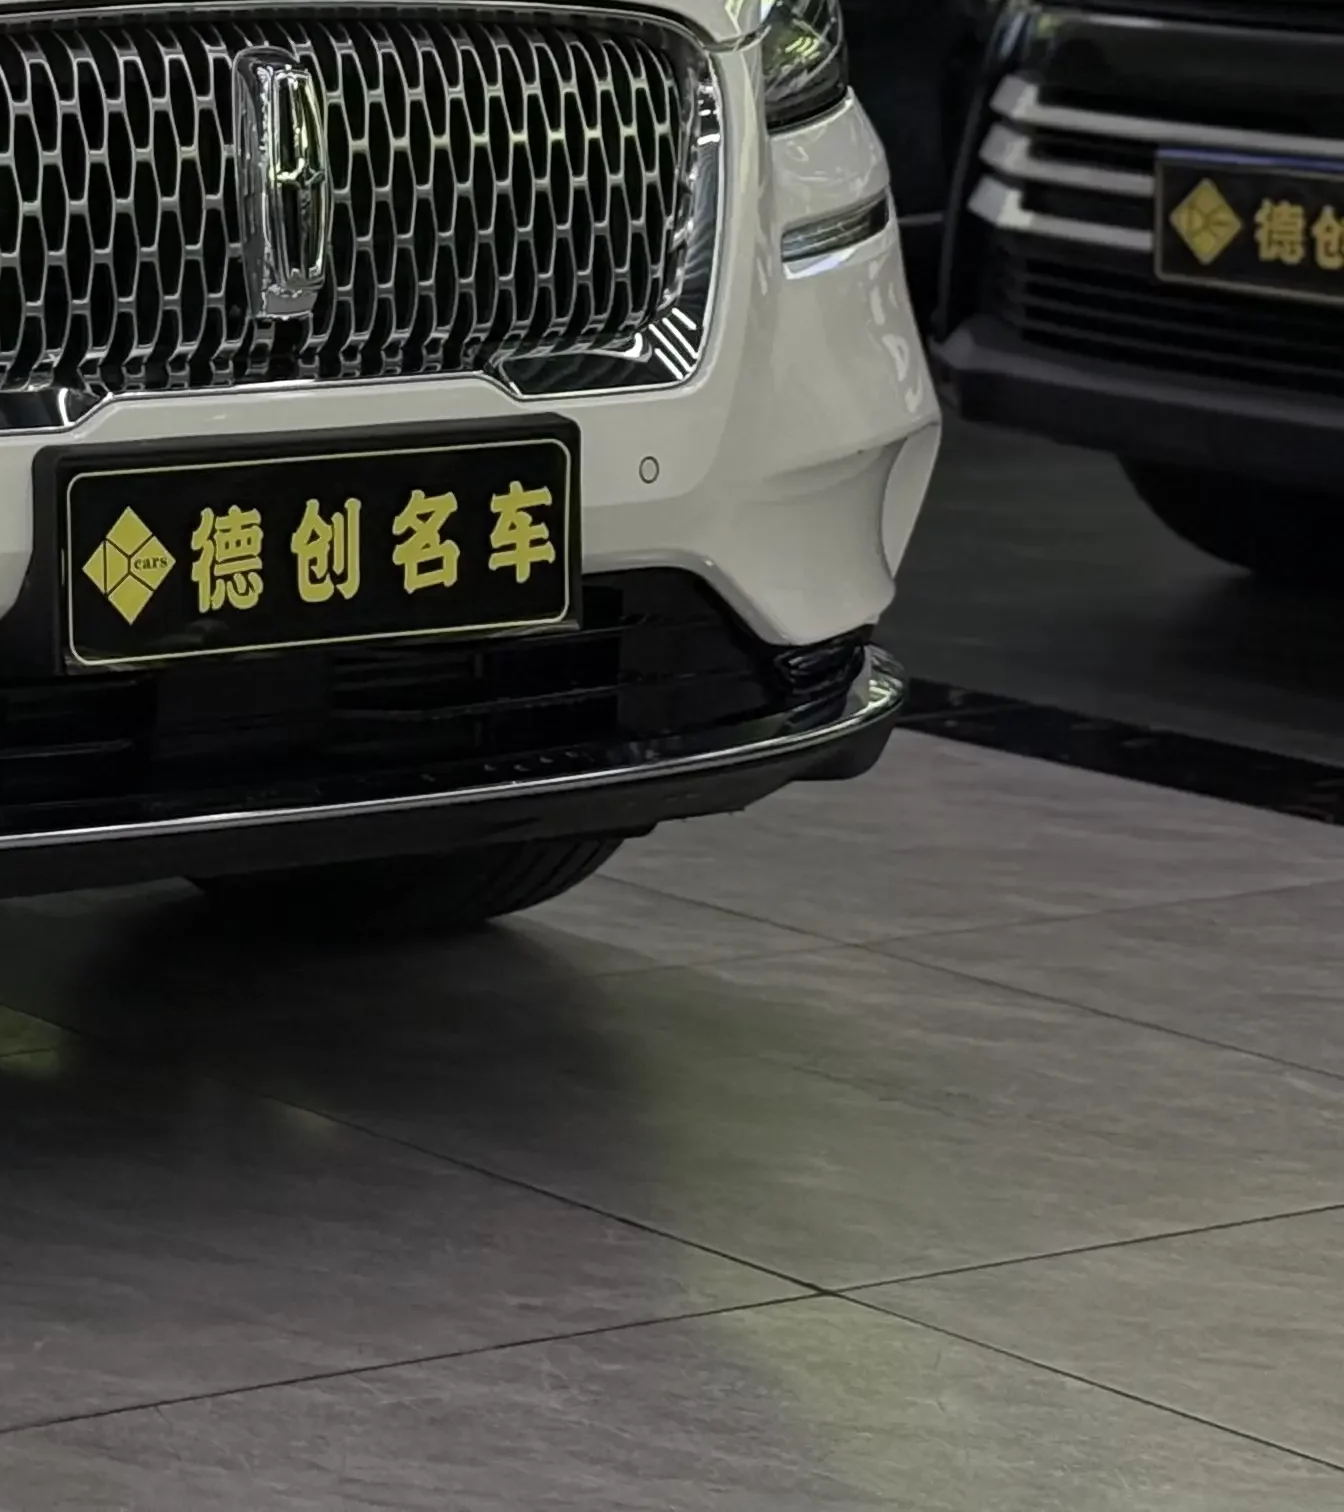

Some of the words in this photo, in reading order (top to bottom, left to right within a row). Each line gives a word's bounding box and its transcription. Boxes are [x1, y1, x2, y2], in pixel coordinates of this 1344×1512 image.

[133, 556, 168, 570] cars
[190, 480, 557, 614] 德创名车
